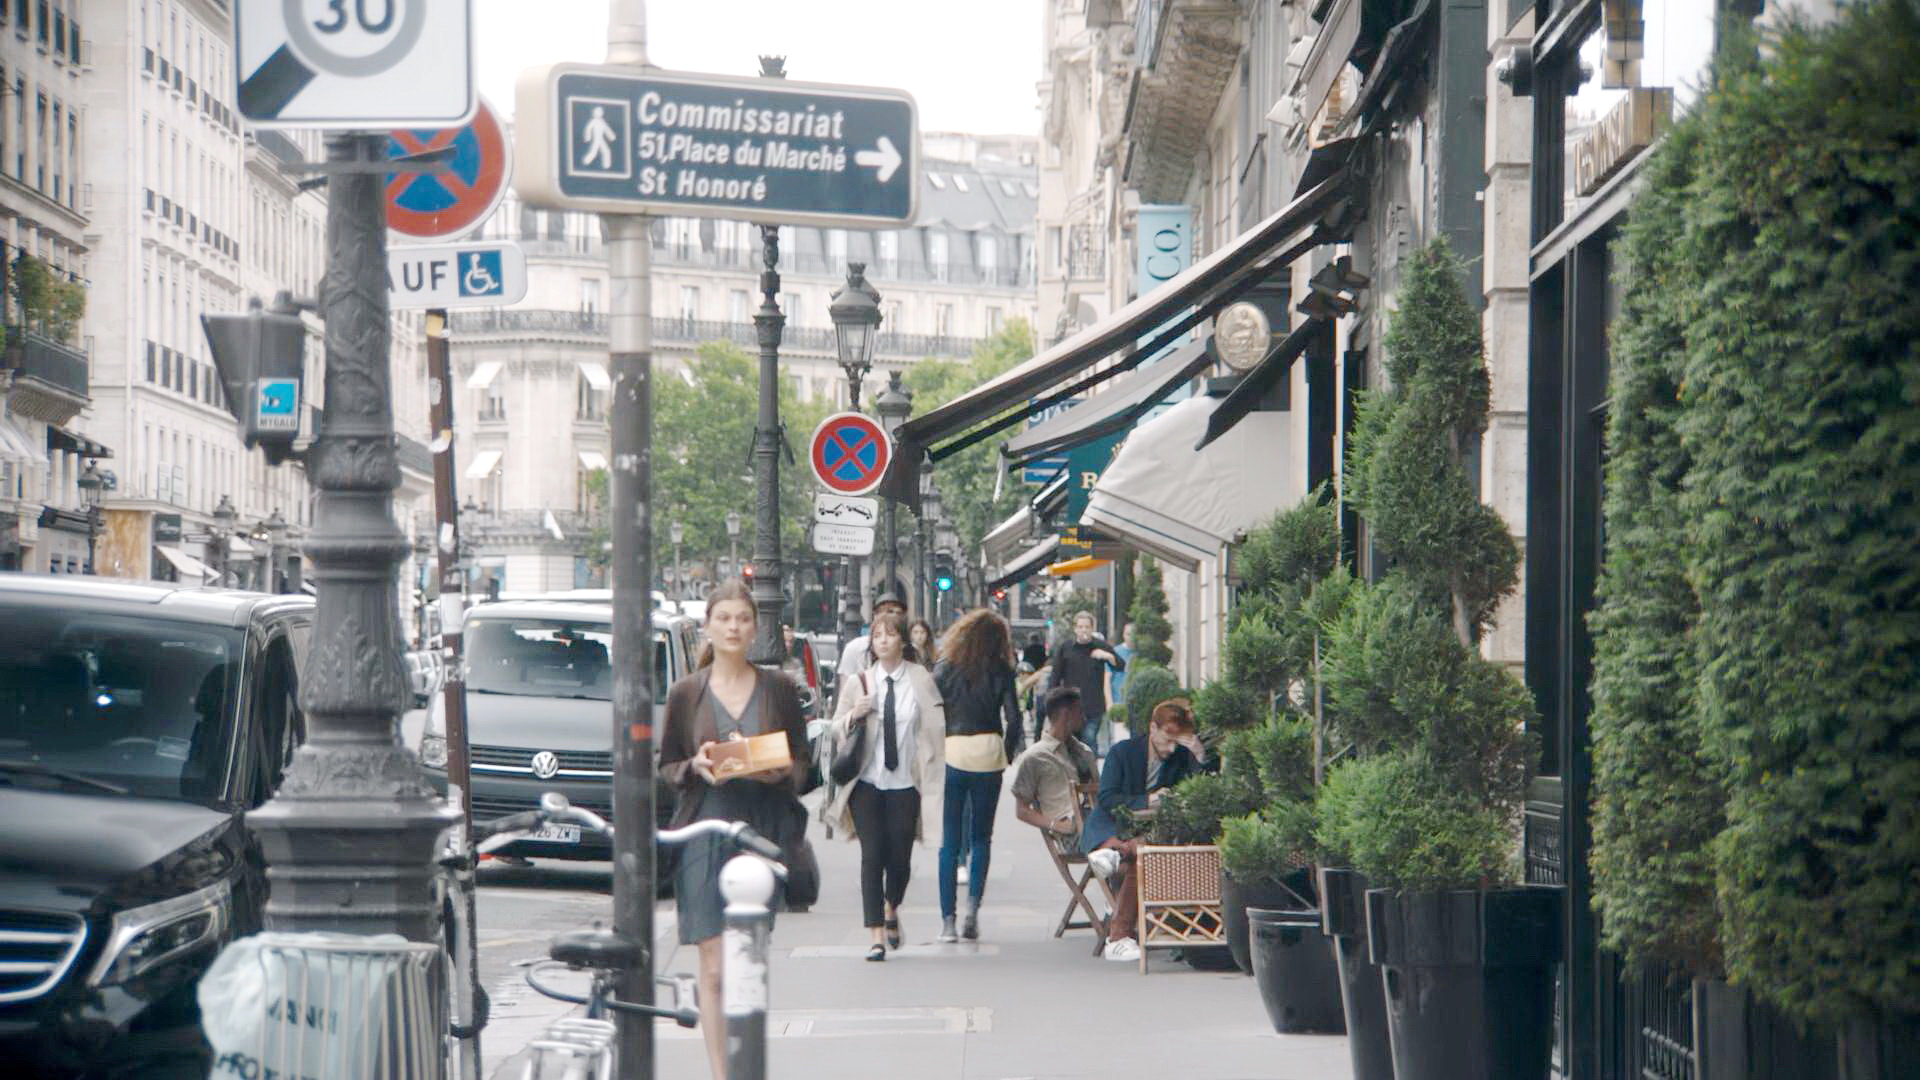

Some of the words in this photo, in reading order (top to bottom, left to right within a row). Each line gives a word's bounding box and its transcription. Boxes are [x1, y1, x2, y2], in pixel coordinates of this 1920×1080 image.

[313, 0, 395, 34] 30
[638, 92, 845, 139] Commissariat
[735, 143, 763, 167] du
[765, 142, 846, 172] Marché
[639, 167, 666, 195] St
[677, 170, 767, 201] Honoré
[387, 260, 449, 292] UF
